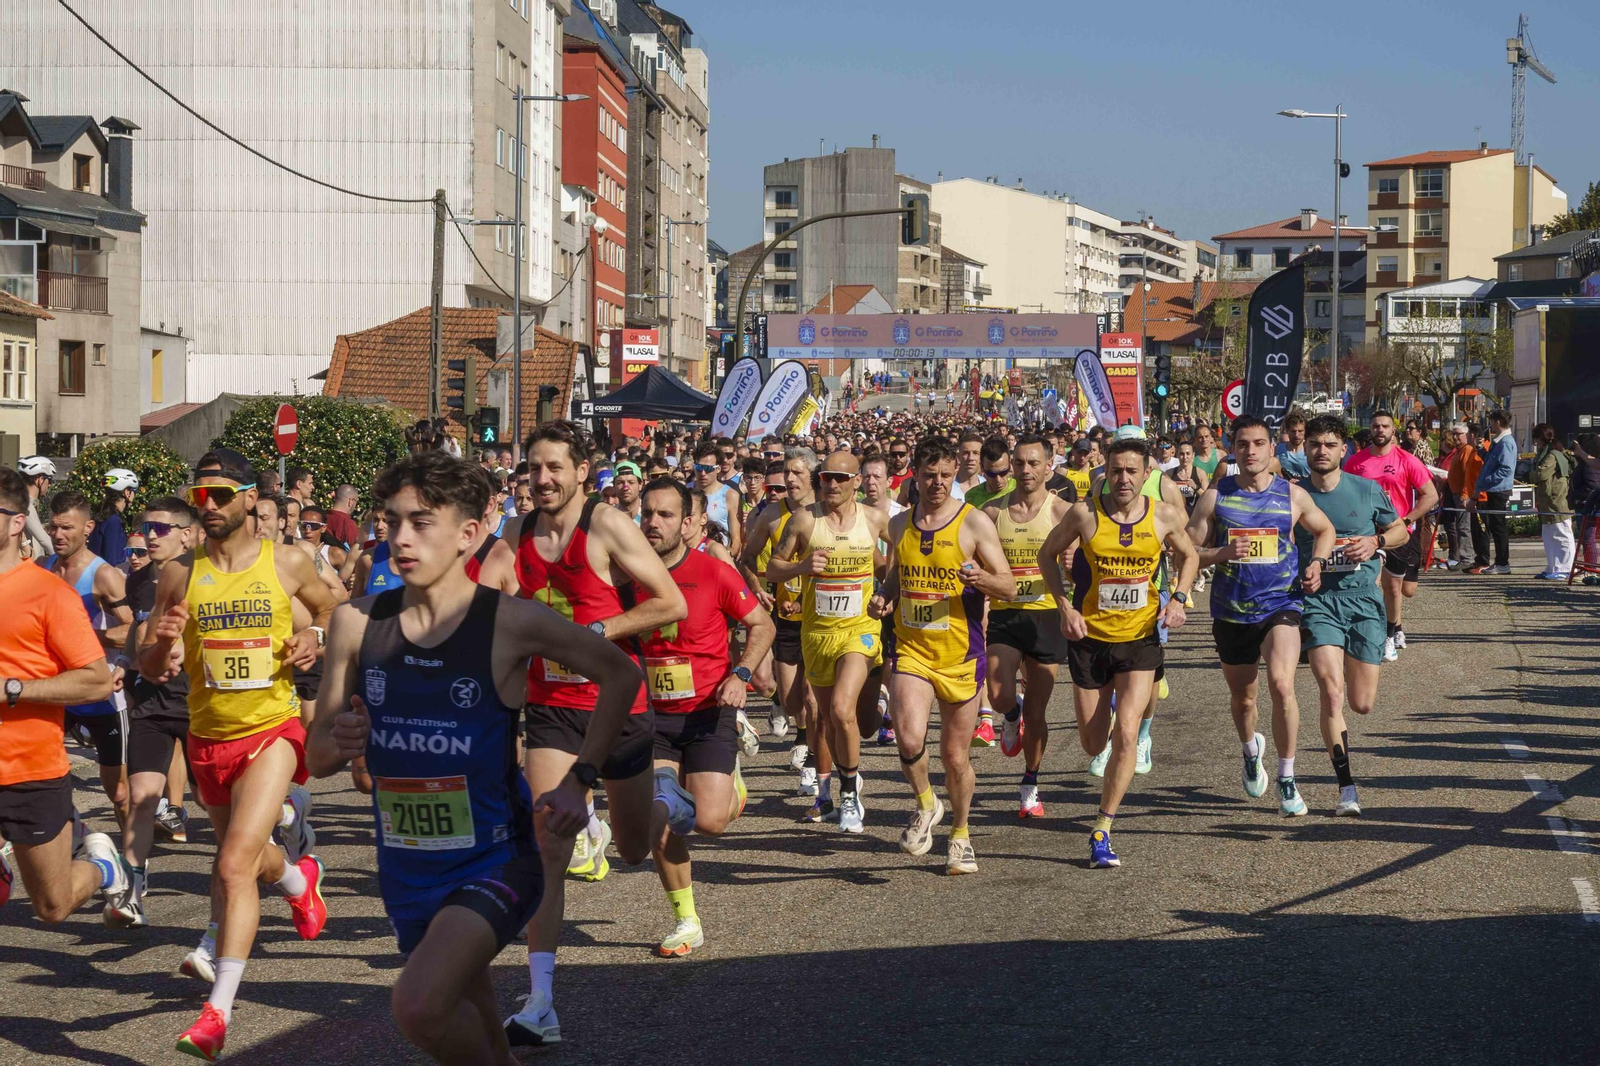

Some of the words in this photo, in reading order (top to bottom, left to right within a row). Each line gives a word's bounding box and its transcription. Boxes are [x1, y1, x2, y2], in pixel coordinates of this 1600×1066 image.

[1106, 367, 1137, 376] GADIS
[725, 367, 753, 414] Porriño
[766, 370, 798, 411] Porriño
[1095, 556, 1154, 566] TANINOS
[901, 565, 956, 580] TANINOS
[1098, 567, 1151, 576] PONTEAREAS
[902, 579, 956, 590] PONTEAREAS
[829, 596, 849, 611] 177
[1111, 589, 1138, 604] 440
[198, 599, 271, 616] ATHLETICS
[914, 605, 932, 622] 113
[200, 618, 222, 632] SAN
[226, 614, 271, 628] LÁZARO
[224, 657, 249, 679] 36
[655, 672, 674, 691] 45
[382, 716, 404, 724] CLUB
[406, 718, 457, 728] ATLETISMO
[371, 728, 471, 755] NARÓN
[392, 803, 454, 835] 2196
